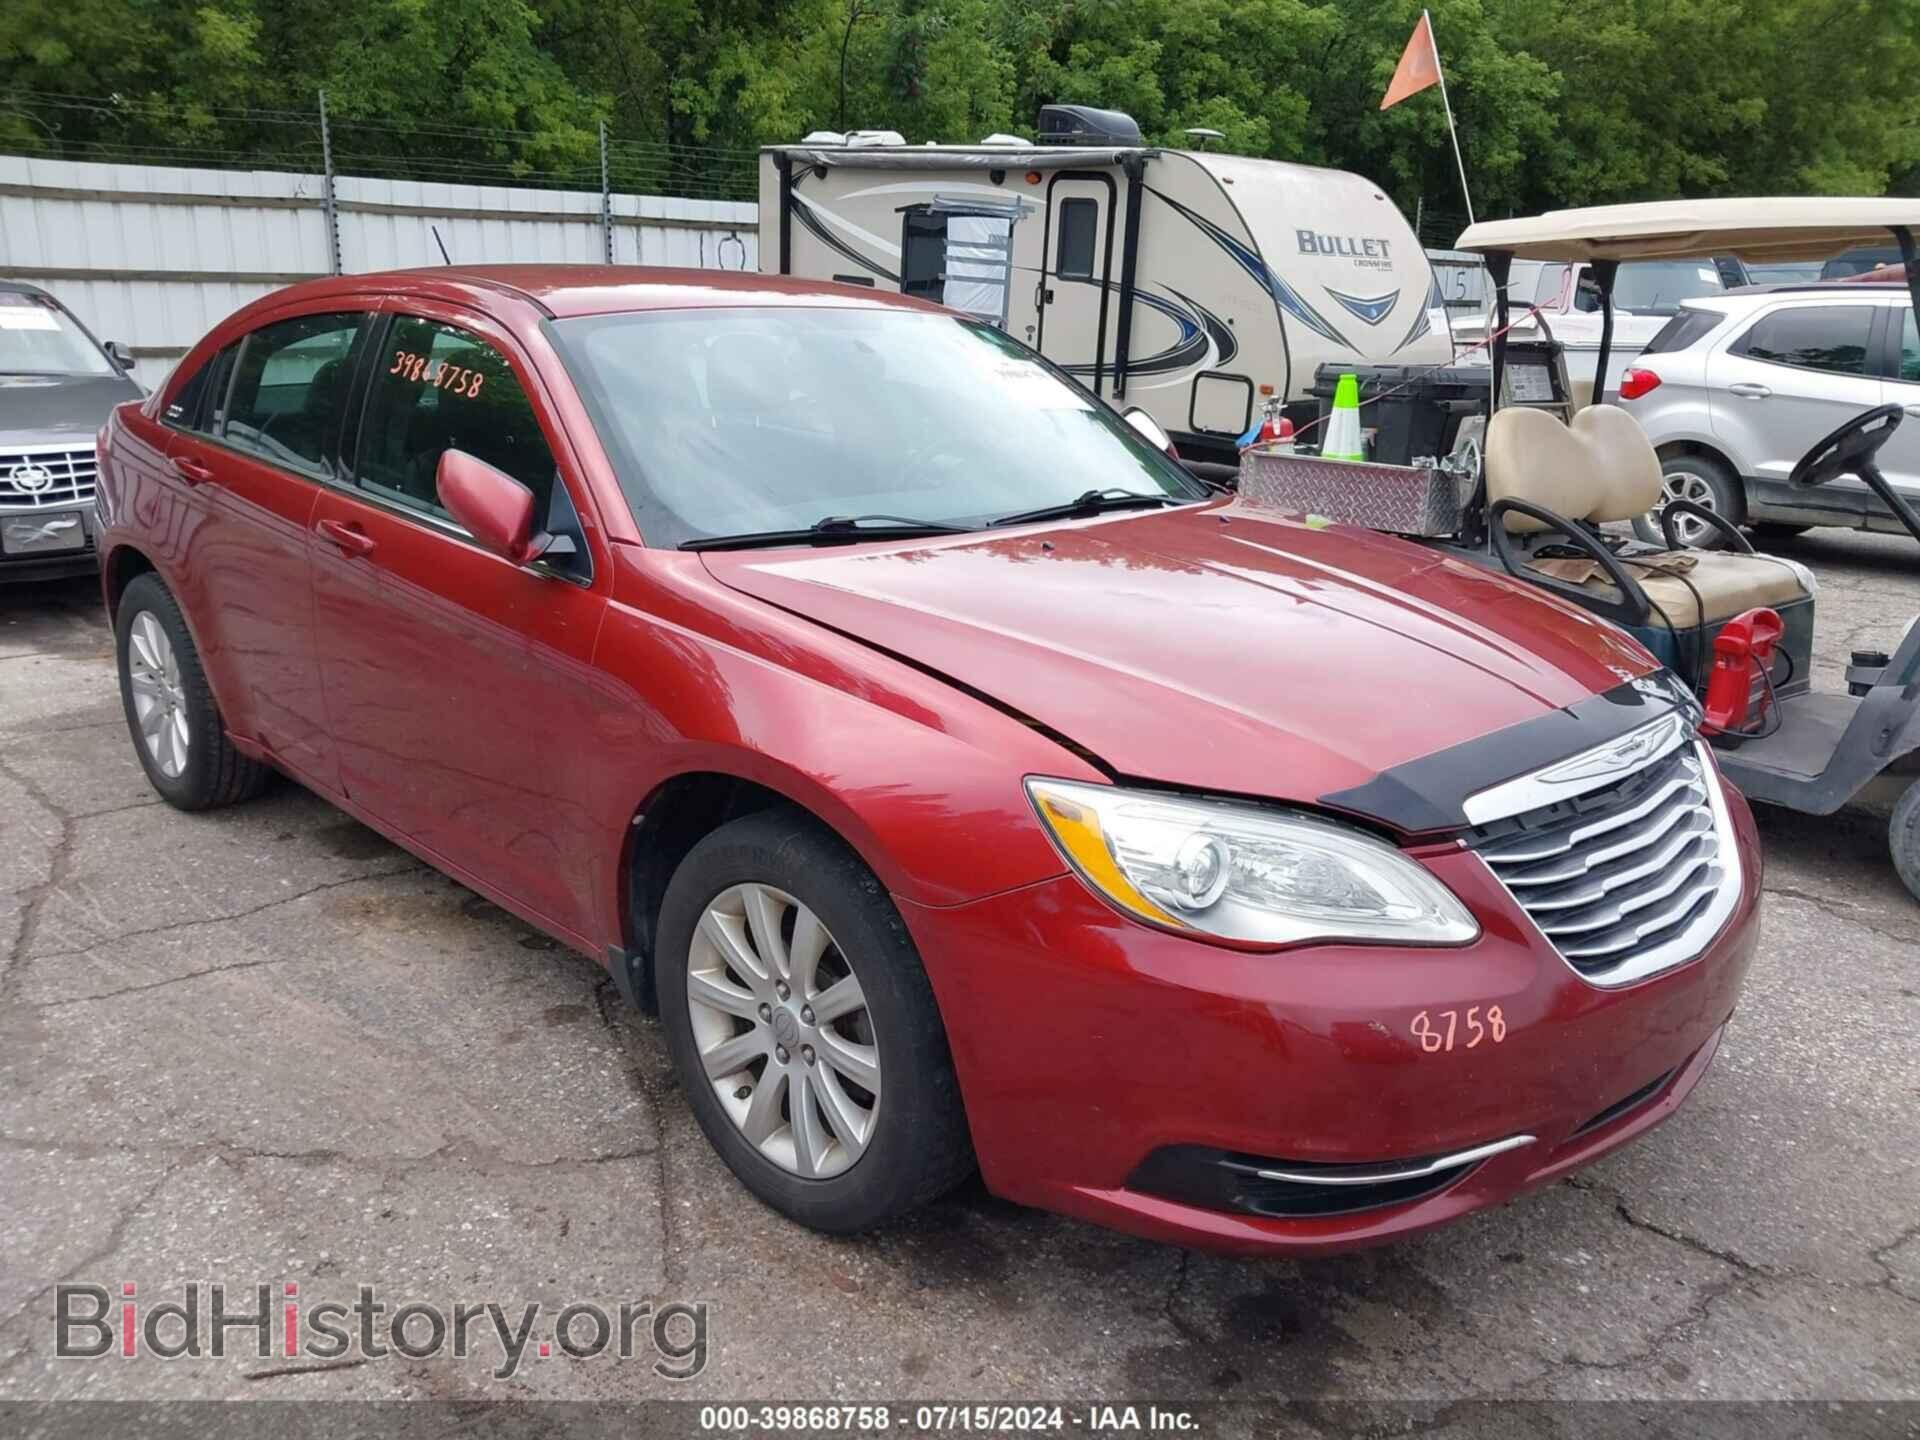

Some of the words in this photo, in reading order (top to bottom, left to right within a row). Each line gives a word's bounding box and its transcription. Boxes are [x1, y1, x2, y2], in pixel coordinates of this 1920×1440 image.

[1296, 229, 1390, 257] BULLET
[390, 351, 483, 398] 39868758
[1410, 1005, 1506, 1052] 8758
